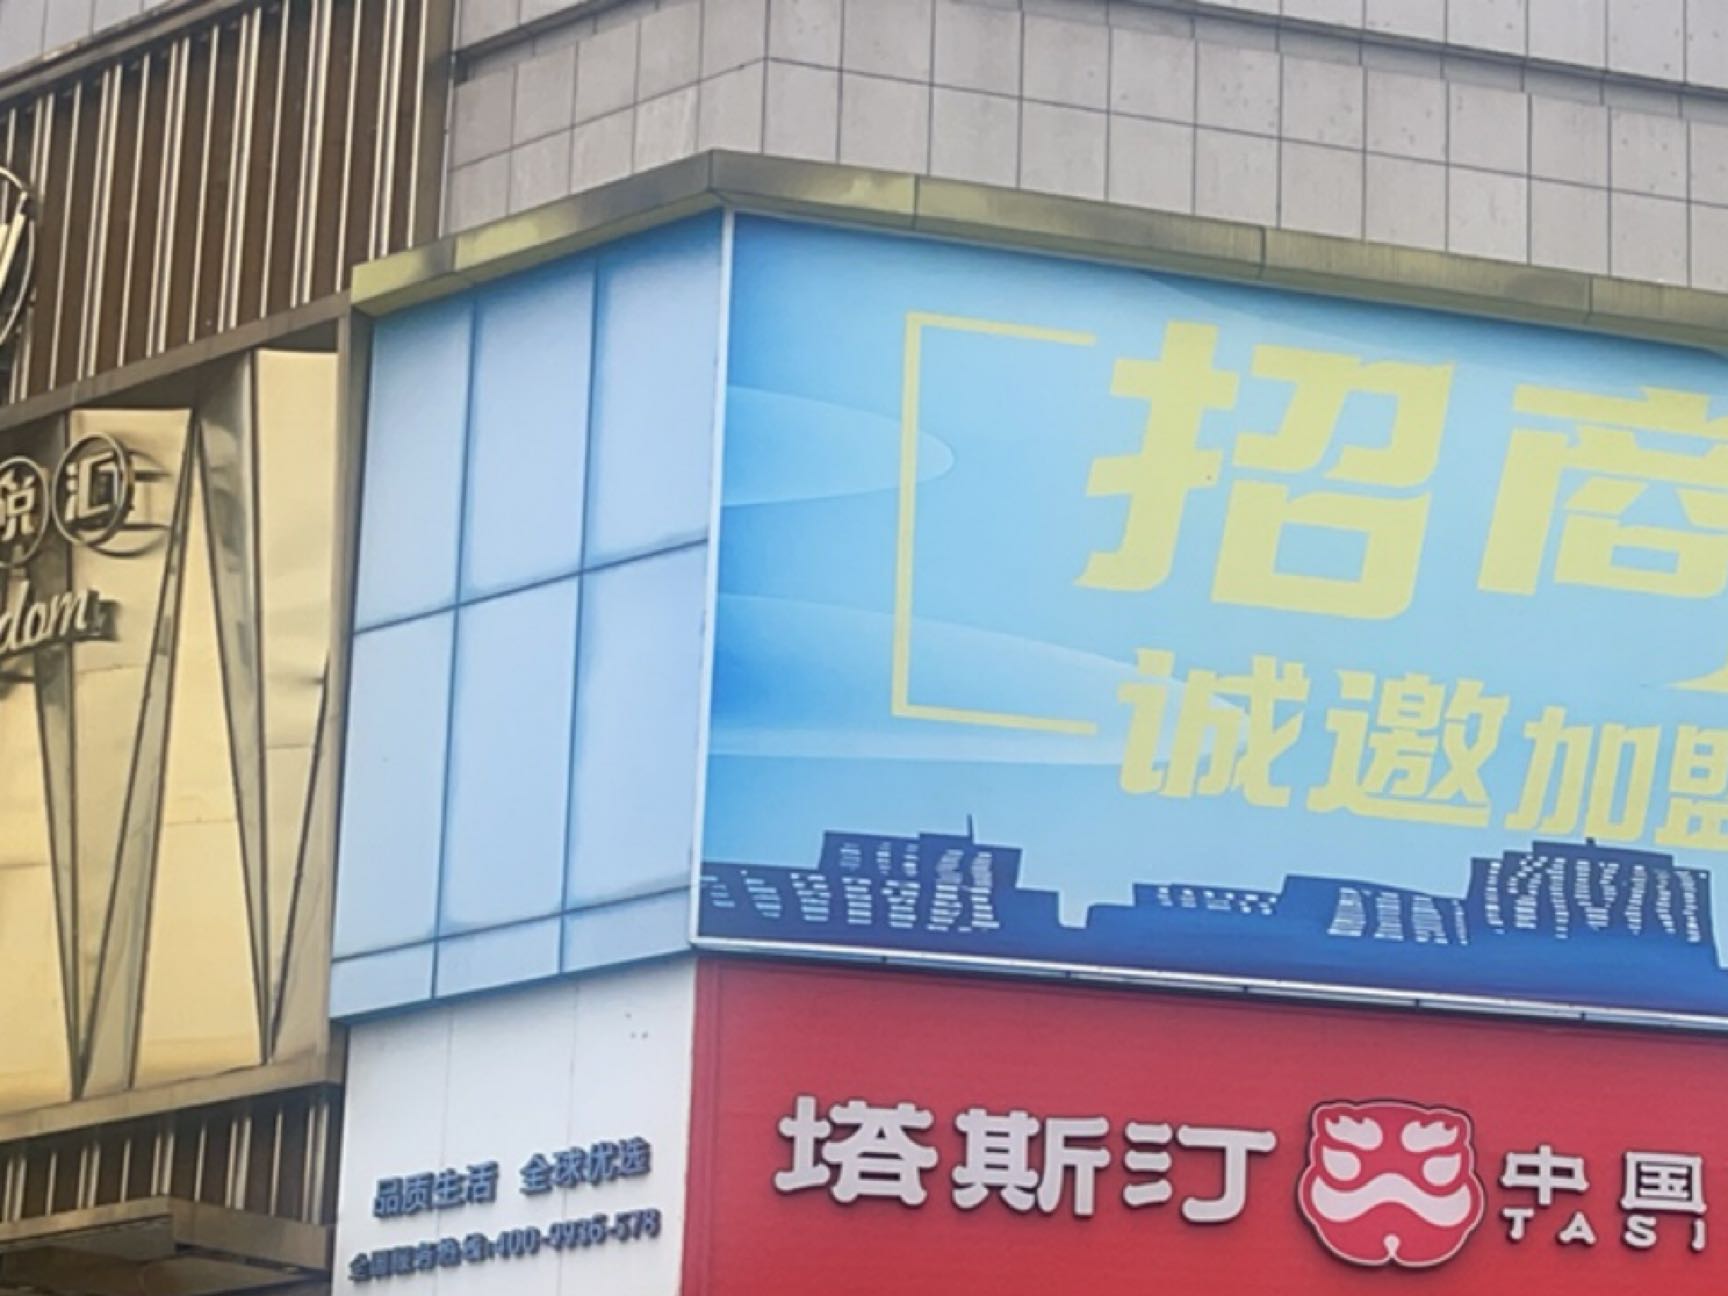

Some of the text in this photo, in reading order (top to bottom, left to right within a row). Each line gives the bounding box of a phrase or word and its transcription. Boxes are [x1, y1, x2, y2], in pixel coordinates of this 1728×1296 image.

[373, 1137, 652, 1218] 品质生活 全球优选
[774, 1096, 1277, 1223] 塔斯汀
